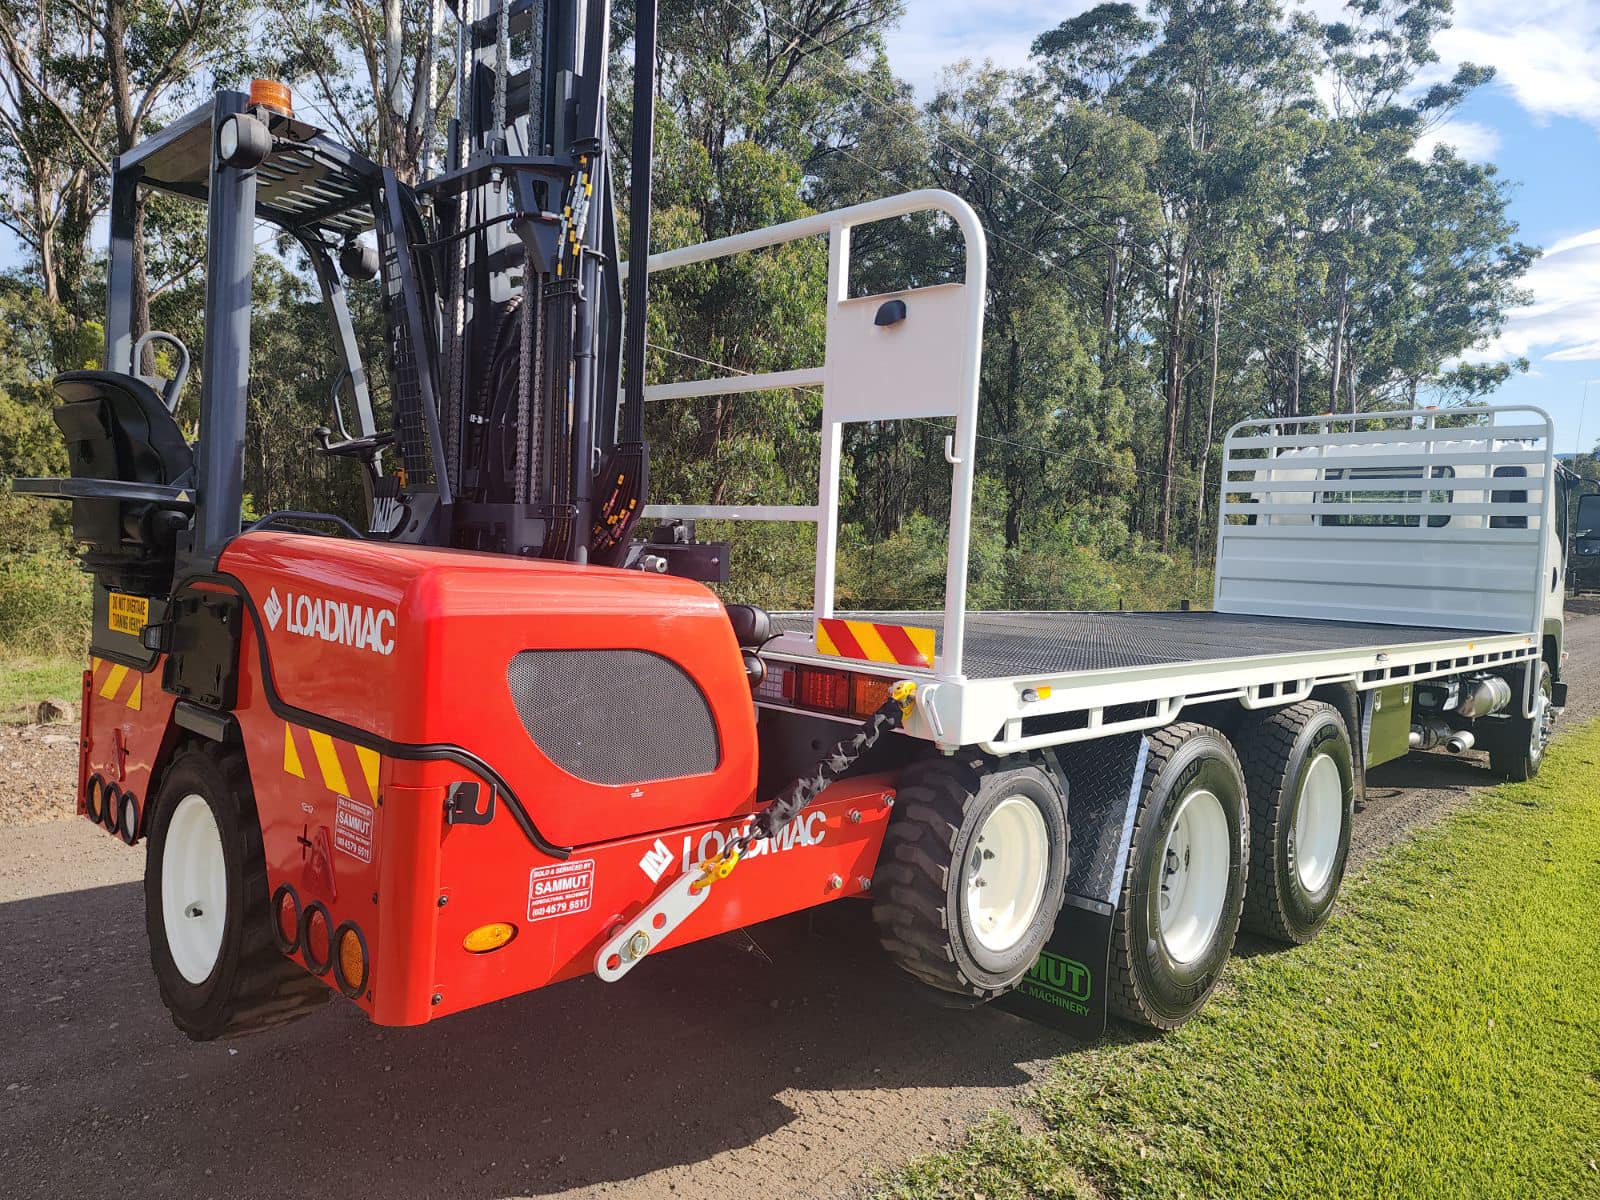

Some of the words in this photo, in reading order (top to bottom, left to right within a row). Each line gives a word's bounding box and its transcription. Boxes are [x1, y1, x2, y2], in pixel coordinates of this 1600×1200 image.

[287, 593, 395, 655] LOADMAC
[339, 811, 370, 834] SAMMUT
[535, 874, 589, 895] SAMMUT
[569, 898, 588, 910] 6511
[1029, 986, 1089, 1016] MACHINERY
